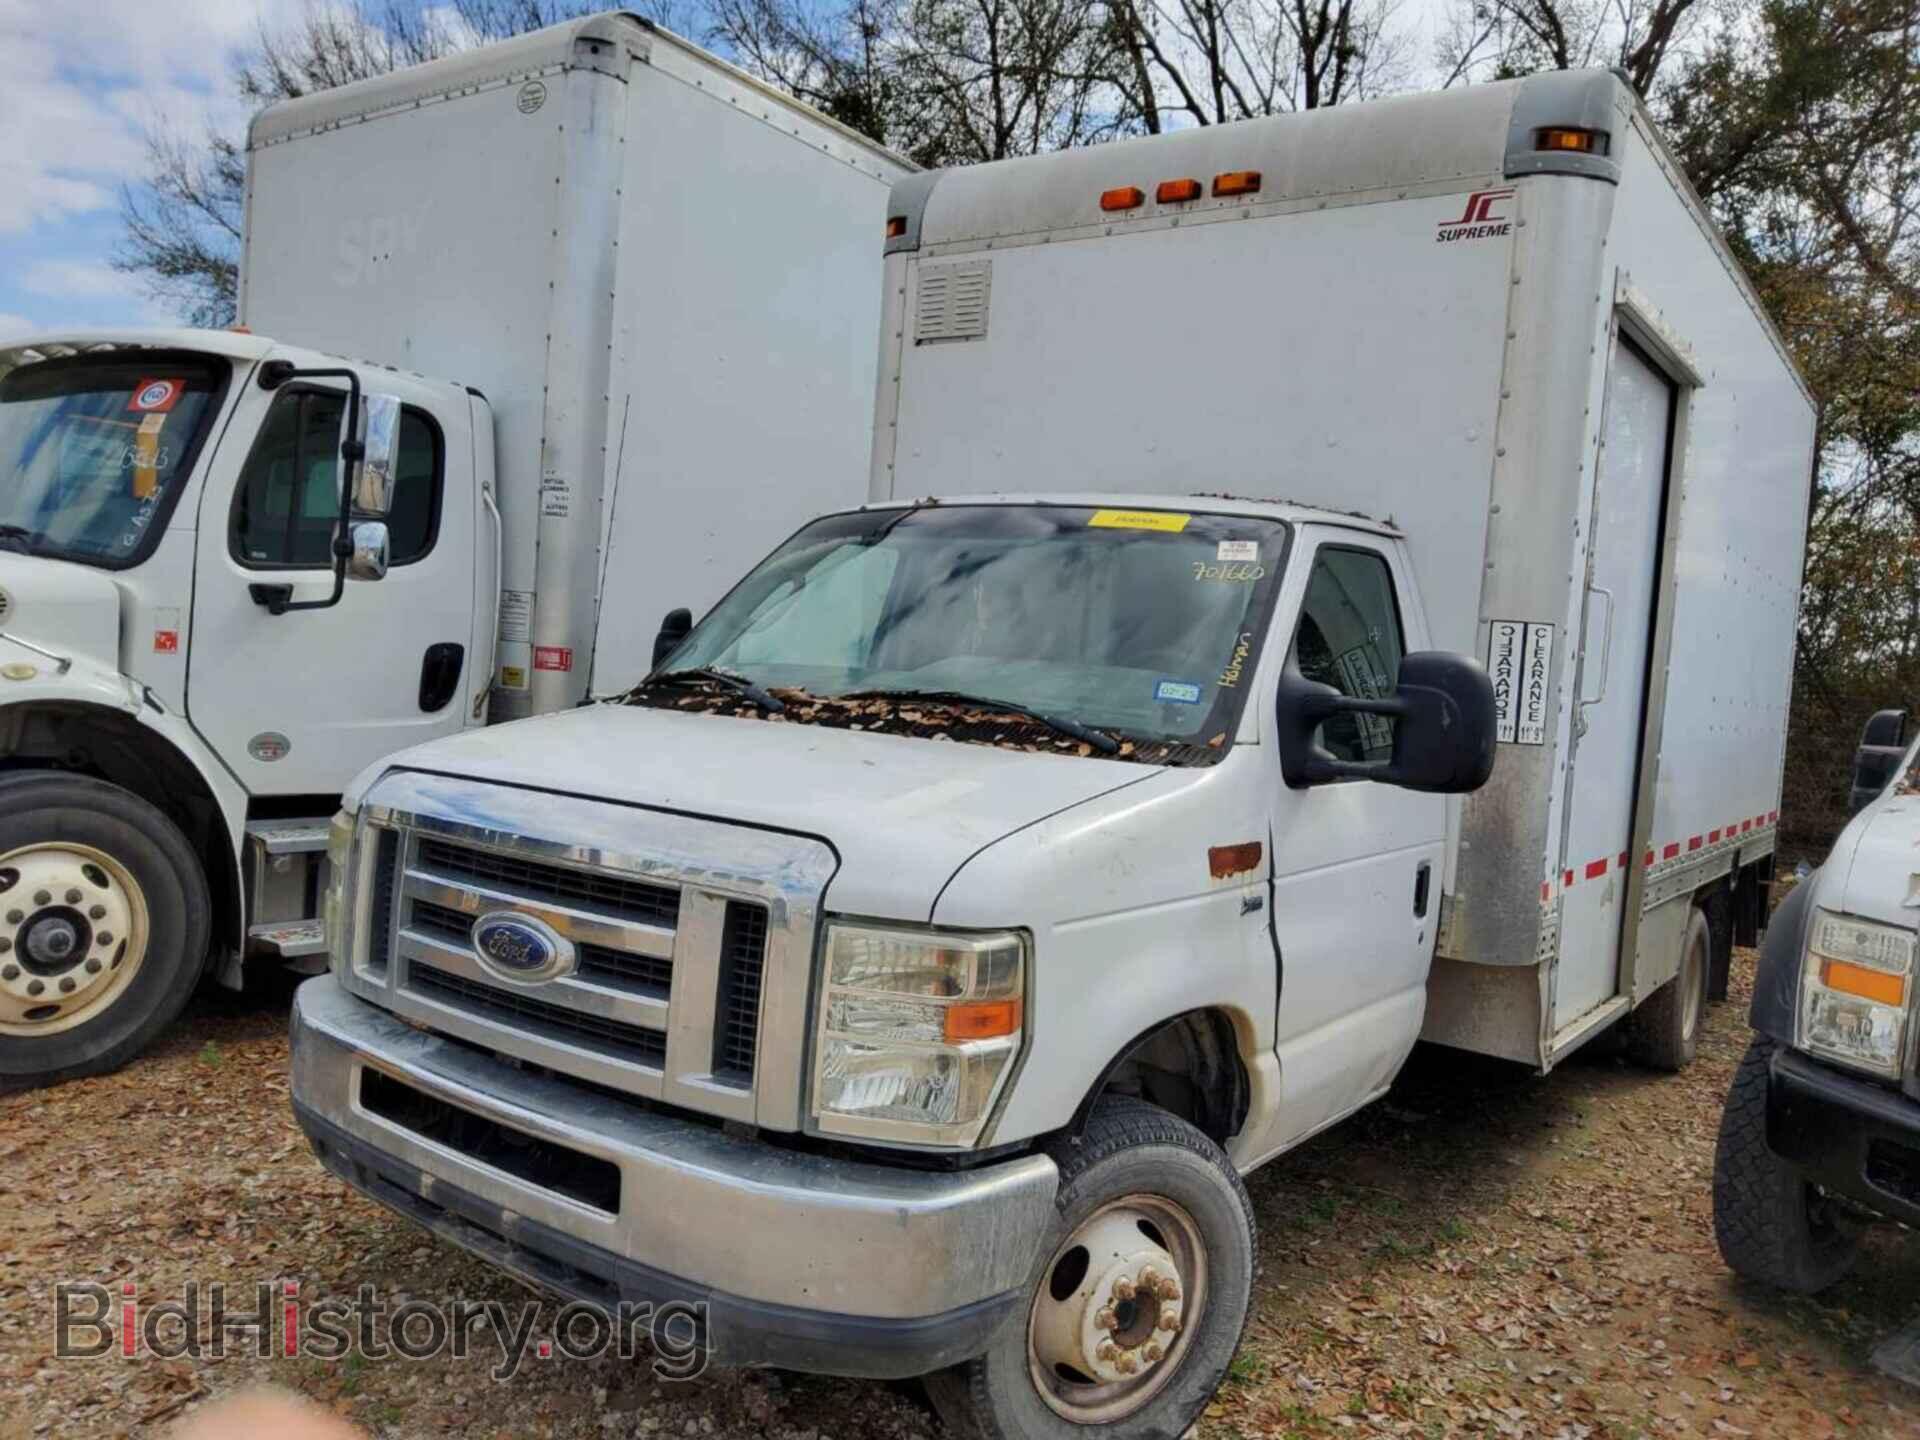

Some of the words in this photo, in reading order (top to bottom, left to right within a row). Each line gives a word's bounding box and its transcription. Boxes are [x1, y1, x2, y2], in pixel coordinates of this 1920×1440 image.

[1436, 223, 1513, 242] SUPREME
[1528, 627, 1547, 722] CLEARANCE
[489, 928, 533, 962] Ford
